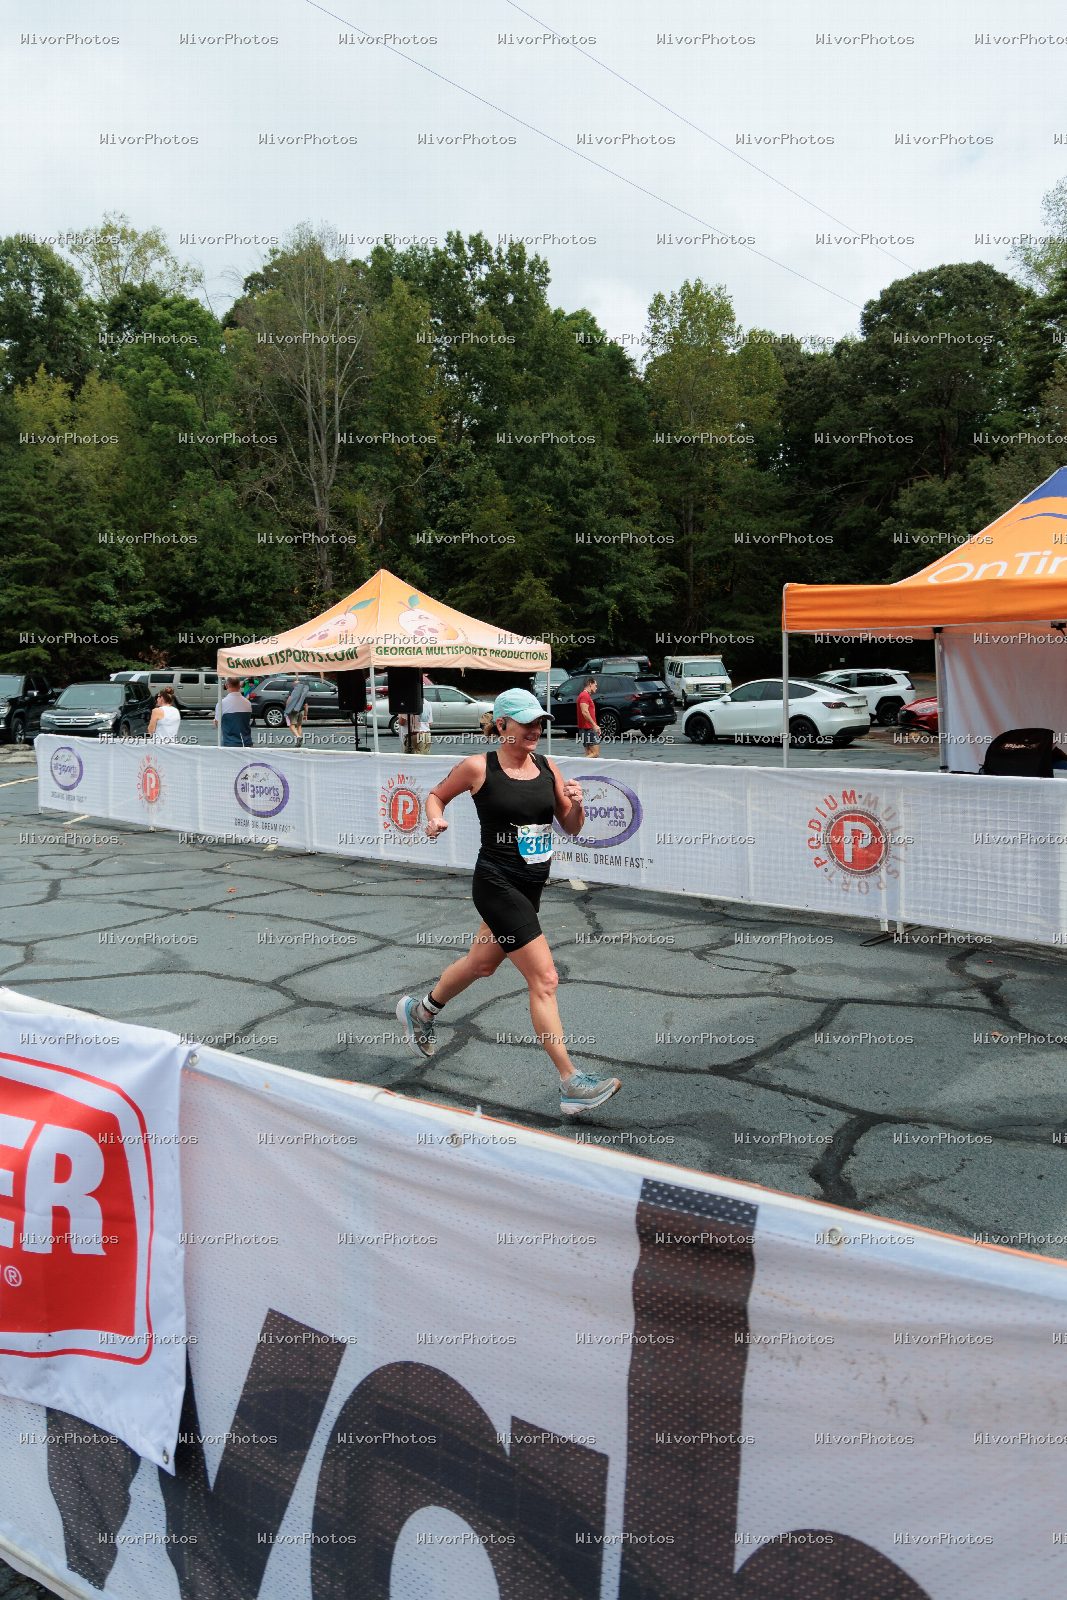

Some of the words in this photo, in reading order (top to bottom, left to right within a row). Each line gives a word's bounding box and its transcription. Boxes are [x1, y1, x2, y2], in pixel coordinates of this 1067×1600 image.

[375, 646, 423, 656] GEORGIA
[425, 645, 487, 657] MULTISPORTS
[490, 649, 548, 661] PRODUCTIONS
[240, 781, 280, 799] all3sports
[398, 794, 415, 825] P
[584, 805, 625, 821] sports
[806, 789, 858, 869] PODIUM
[843, 820, 872, 864] P
[552, 850, 573, 861] REAM
[575, 852, 591, 864] BIG.
[593, 853, 622, 867] DREAM
